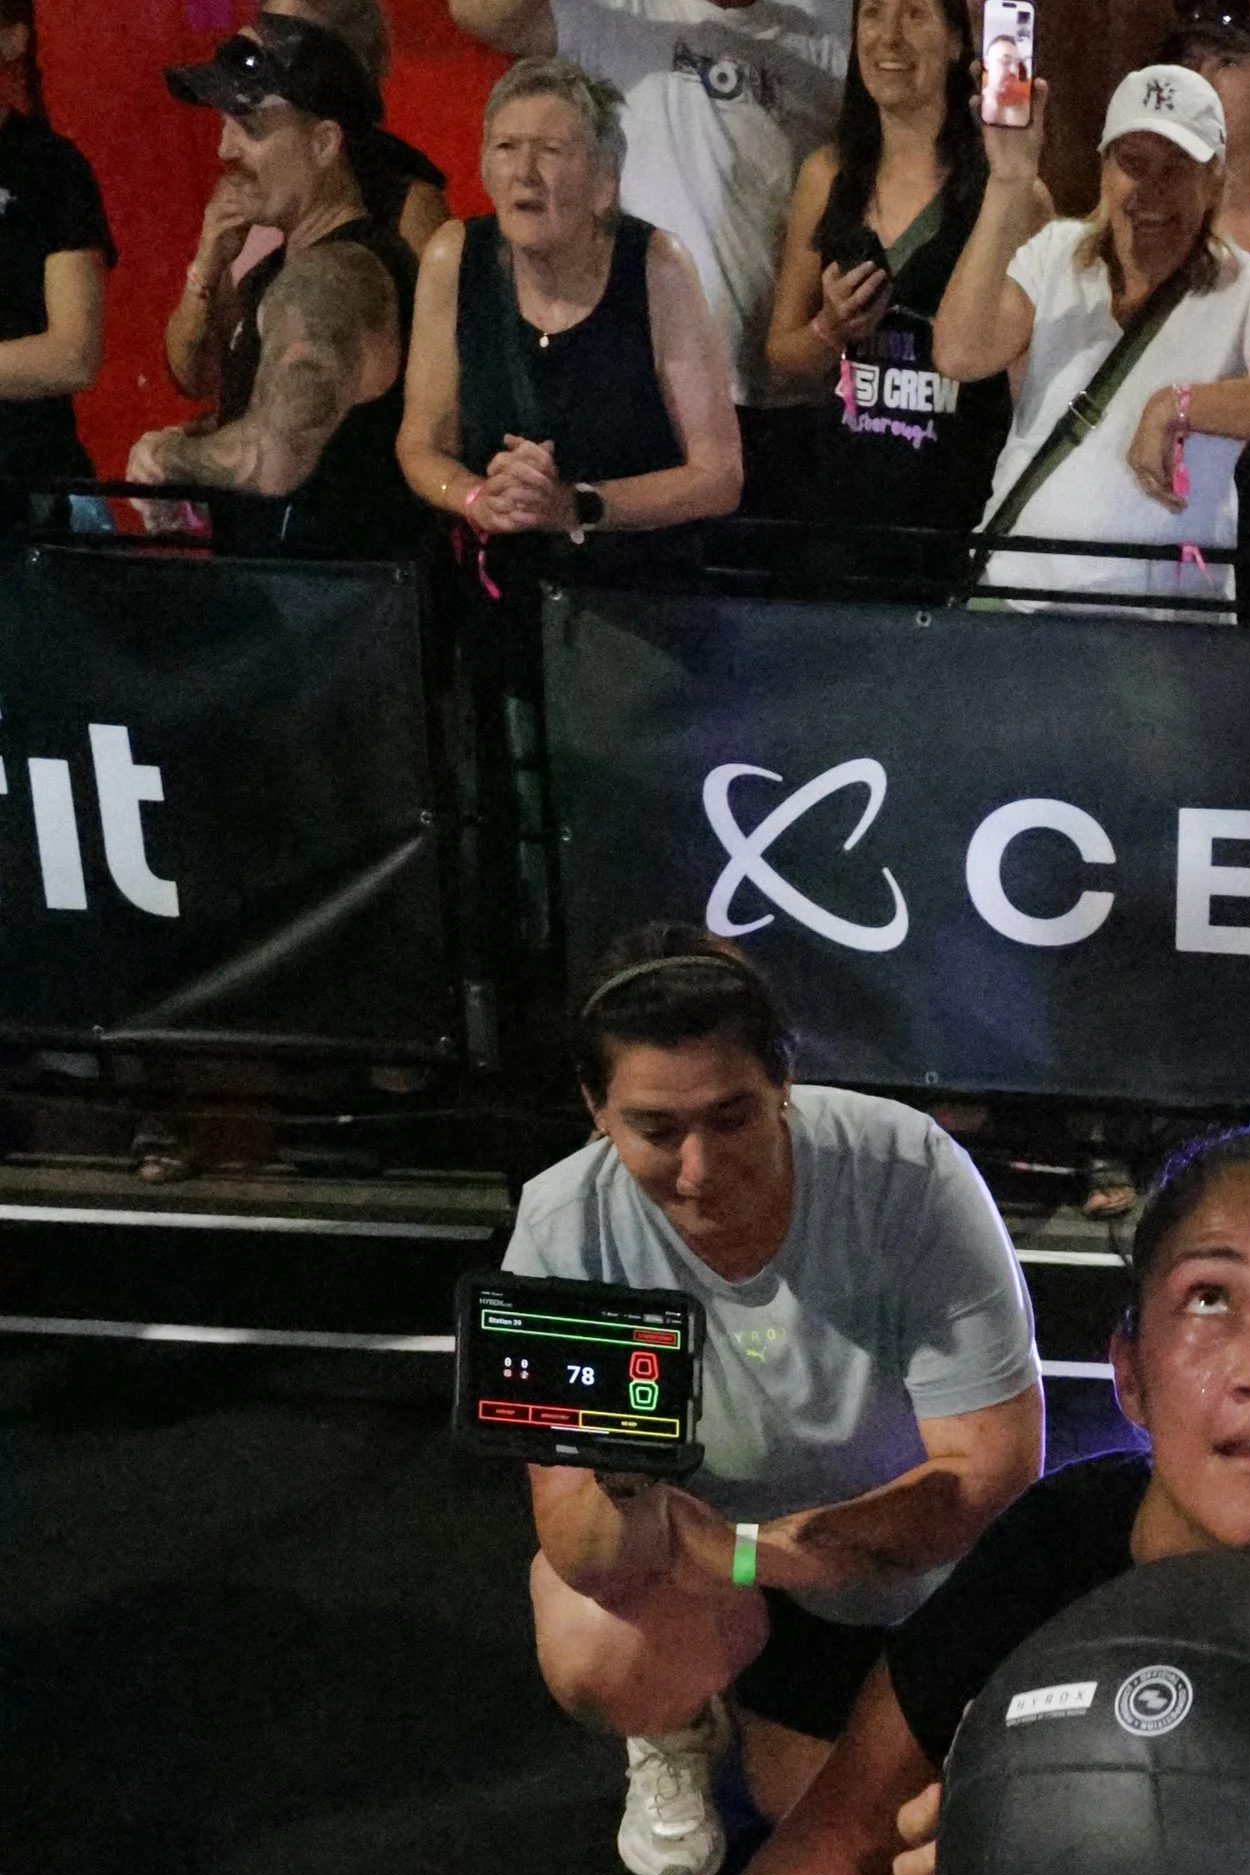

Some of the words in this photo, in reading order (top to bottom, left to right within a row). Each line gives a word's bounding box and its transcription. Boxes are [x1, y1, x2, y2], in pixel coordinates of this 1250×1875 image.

[883, 367, 961, 414] CREW
[0, 722, 181, 918] it
[566, 1364, 596, 1386] 78
[1017, 1690, 1085, 1711] HYROX
